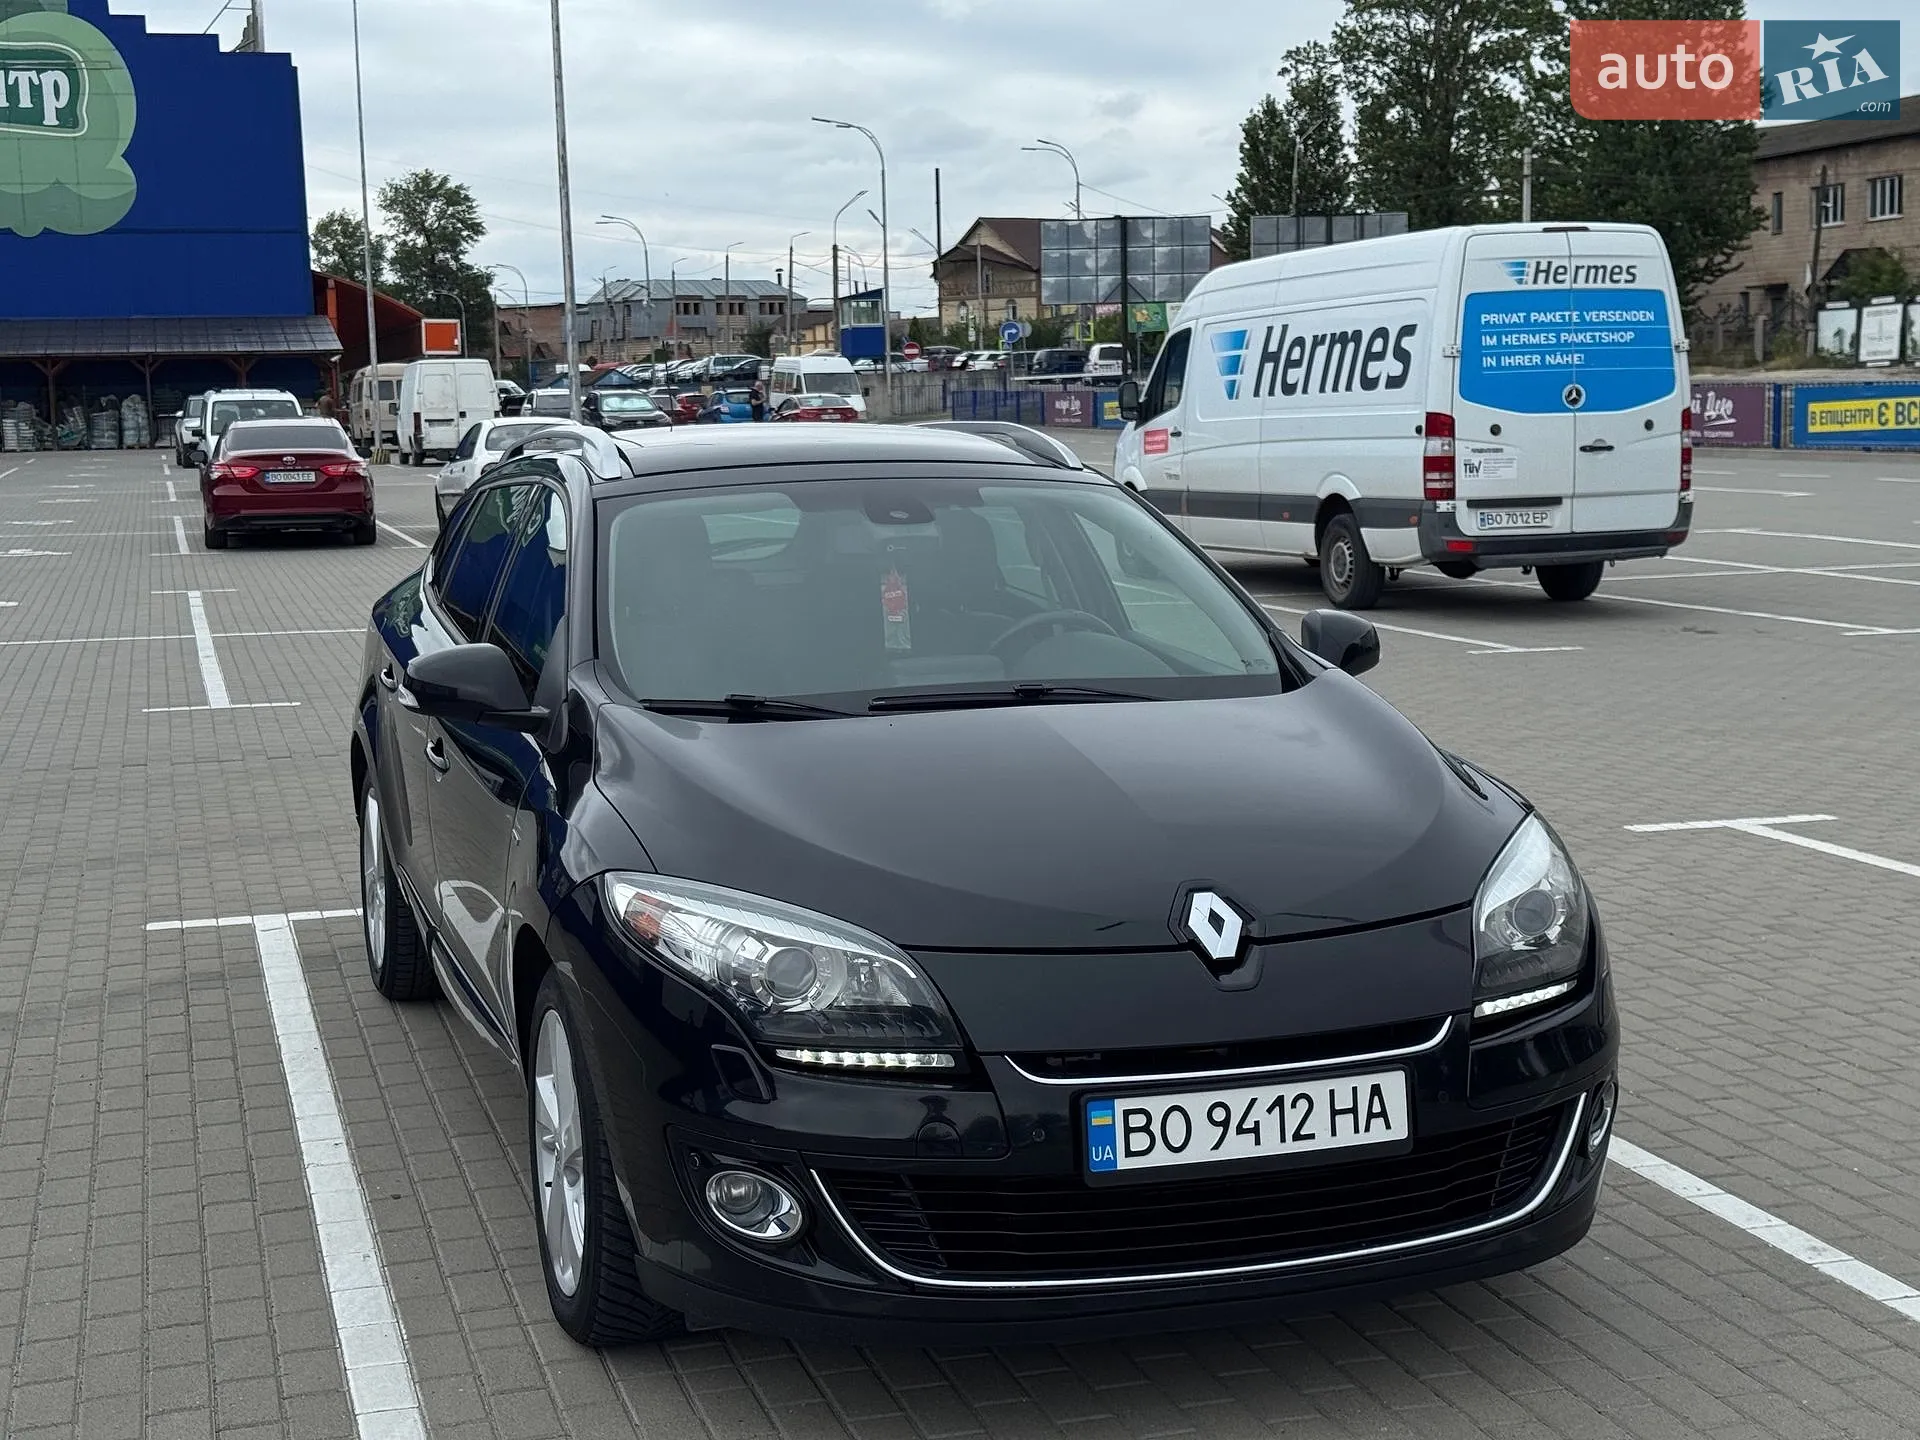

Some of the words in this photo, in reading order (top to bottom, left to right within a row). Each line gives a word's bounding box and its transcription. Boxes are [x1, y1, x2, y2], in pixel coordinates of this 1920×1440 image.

[1532, 260, 1638, 285] Hermes
[1480, 312, 1527, 325] PRIVAT
[1530, 311, 1581, 323] PAKETE
[1584, 310, 1655, 323] VERSENDEN
[1481, 334, 1498, 346] IM
[1502, 333, 1557, 345] HERMES
[1560, 331, 1636, 344] PAKETSHOP
[1253, 323, 1418, 398] Hermes
[1482, 355, 1497, 368] IN
[1501, 354, 1542, 367] IHRER
[1810, 411, 1817, 426] В
[1819, 408, 1874, 427] ЕПІЦЕНТРІ
[1877, 402, 1889, 427] Є
[1486, 513, 1503, 526] BO
[1505, 513, 1531, 525] 7012
[1533, 512, 1549, 524] EP
[1122, 1104, 1193, 1159] BO
[1206, 1092, 1316, 1151] 9412
[1329, 1082, 1392, 1137] HA
[1092, 1145, 1115, 1162] UA
